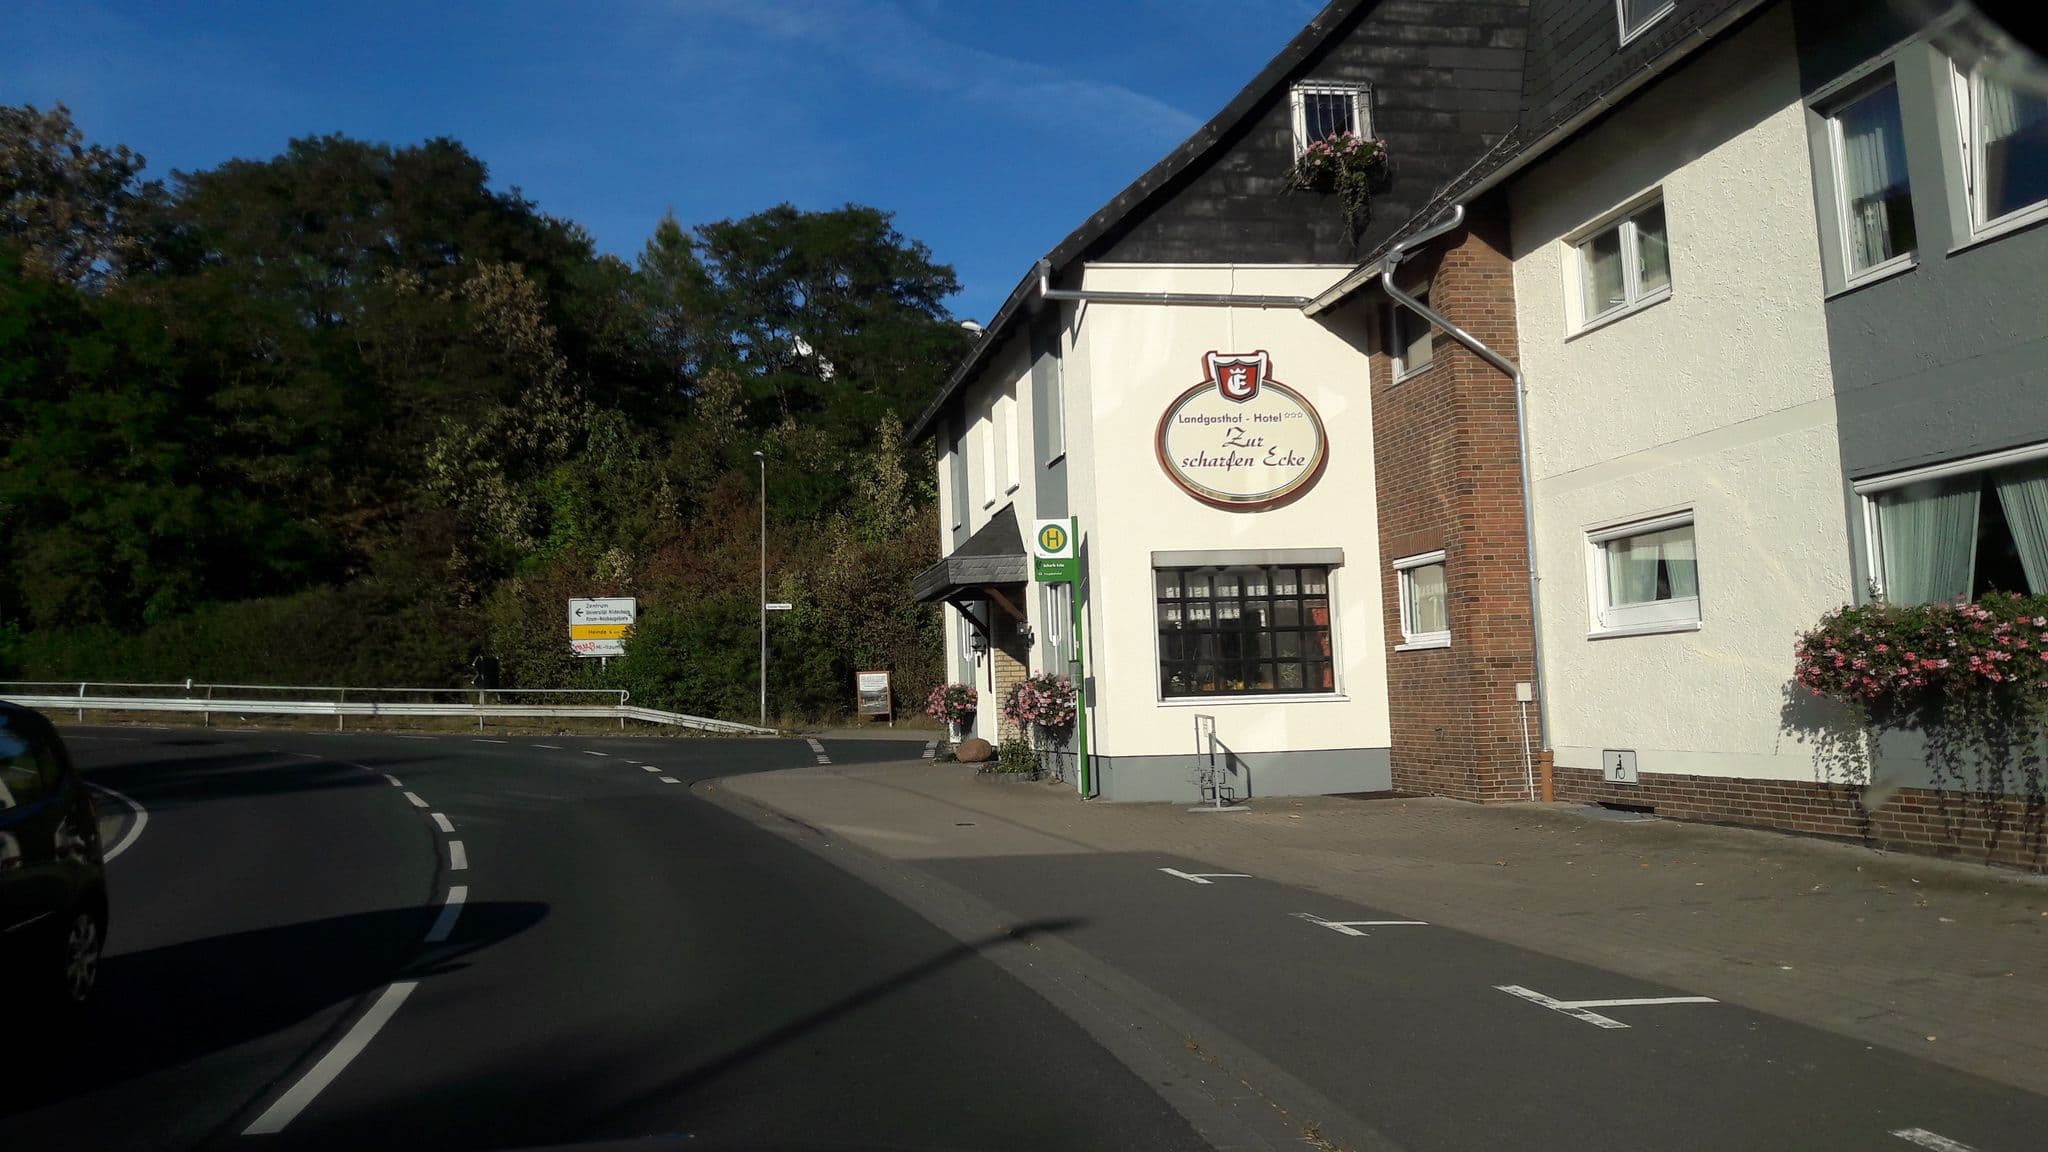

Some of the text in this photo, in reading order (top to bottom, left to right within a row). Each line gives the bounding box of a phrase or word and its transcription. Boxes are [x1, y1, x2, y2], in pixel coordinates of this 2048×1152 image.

[1178, 413, 1242, 425] Landgasthof
[1253, 412, 1282, 423] Hotel
[1222, 426, 1264, 448] Zur
[1181, 446, 1305, 472] scharfen Ecke
[1047, 530, 1059, 547] H
